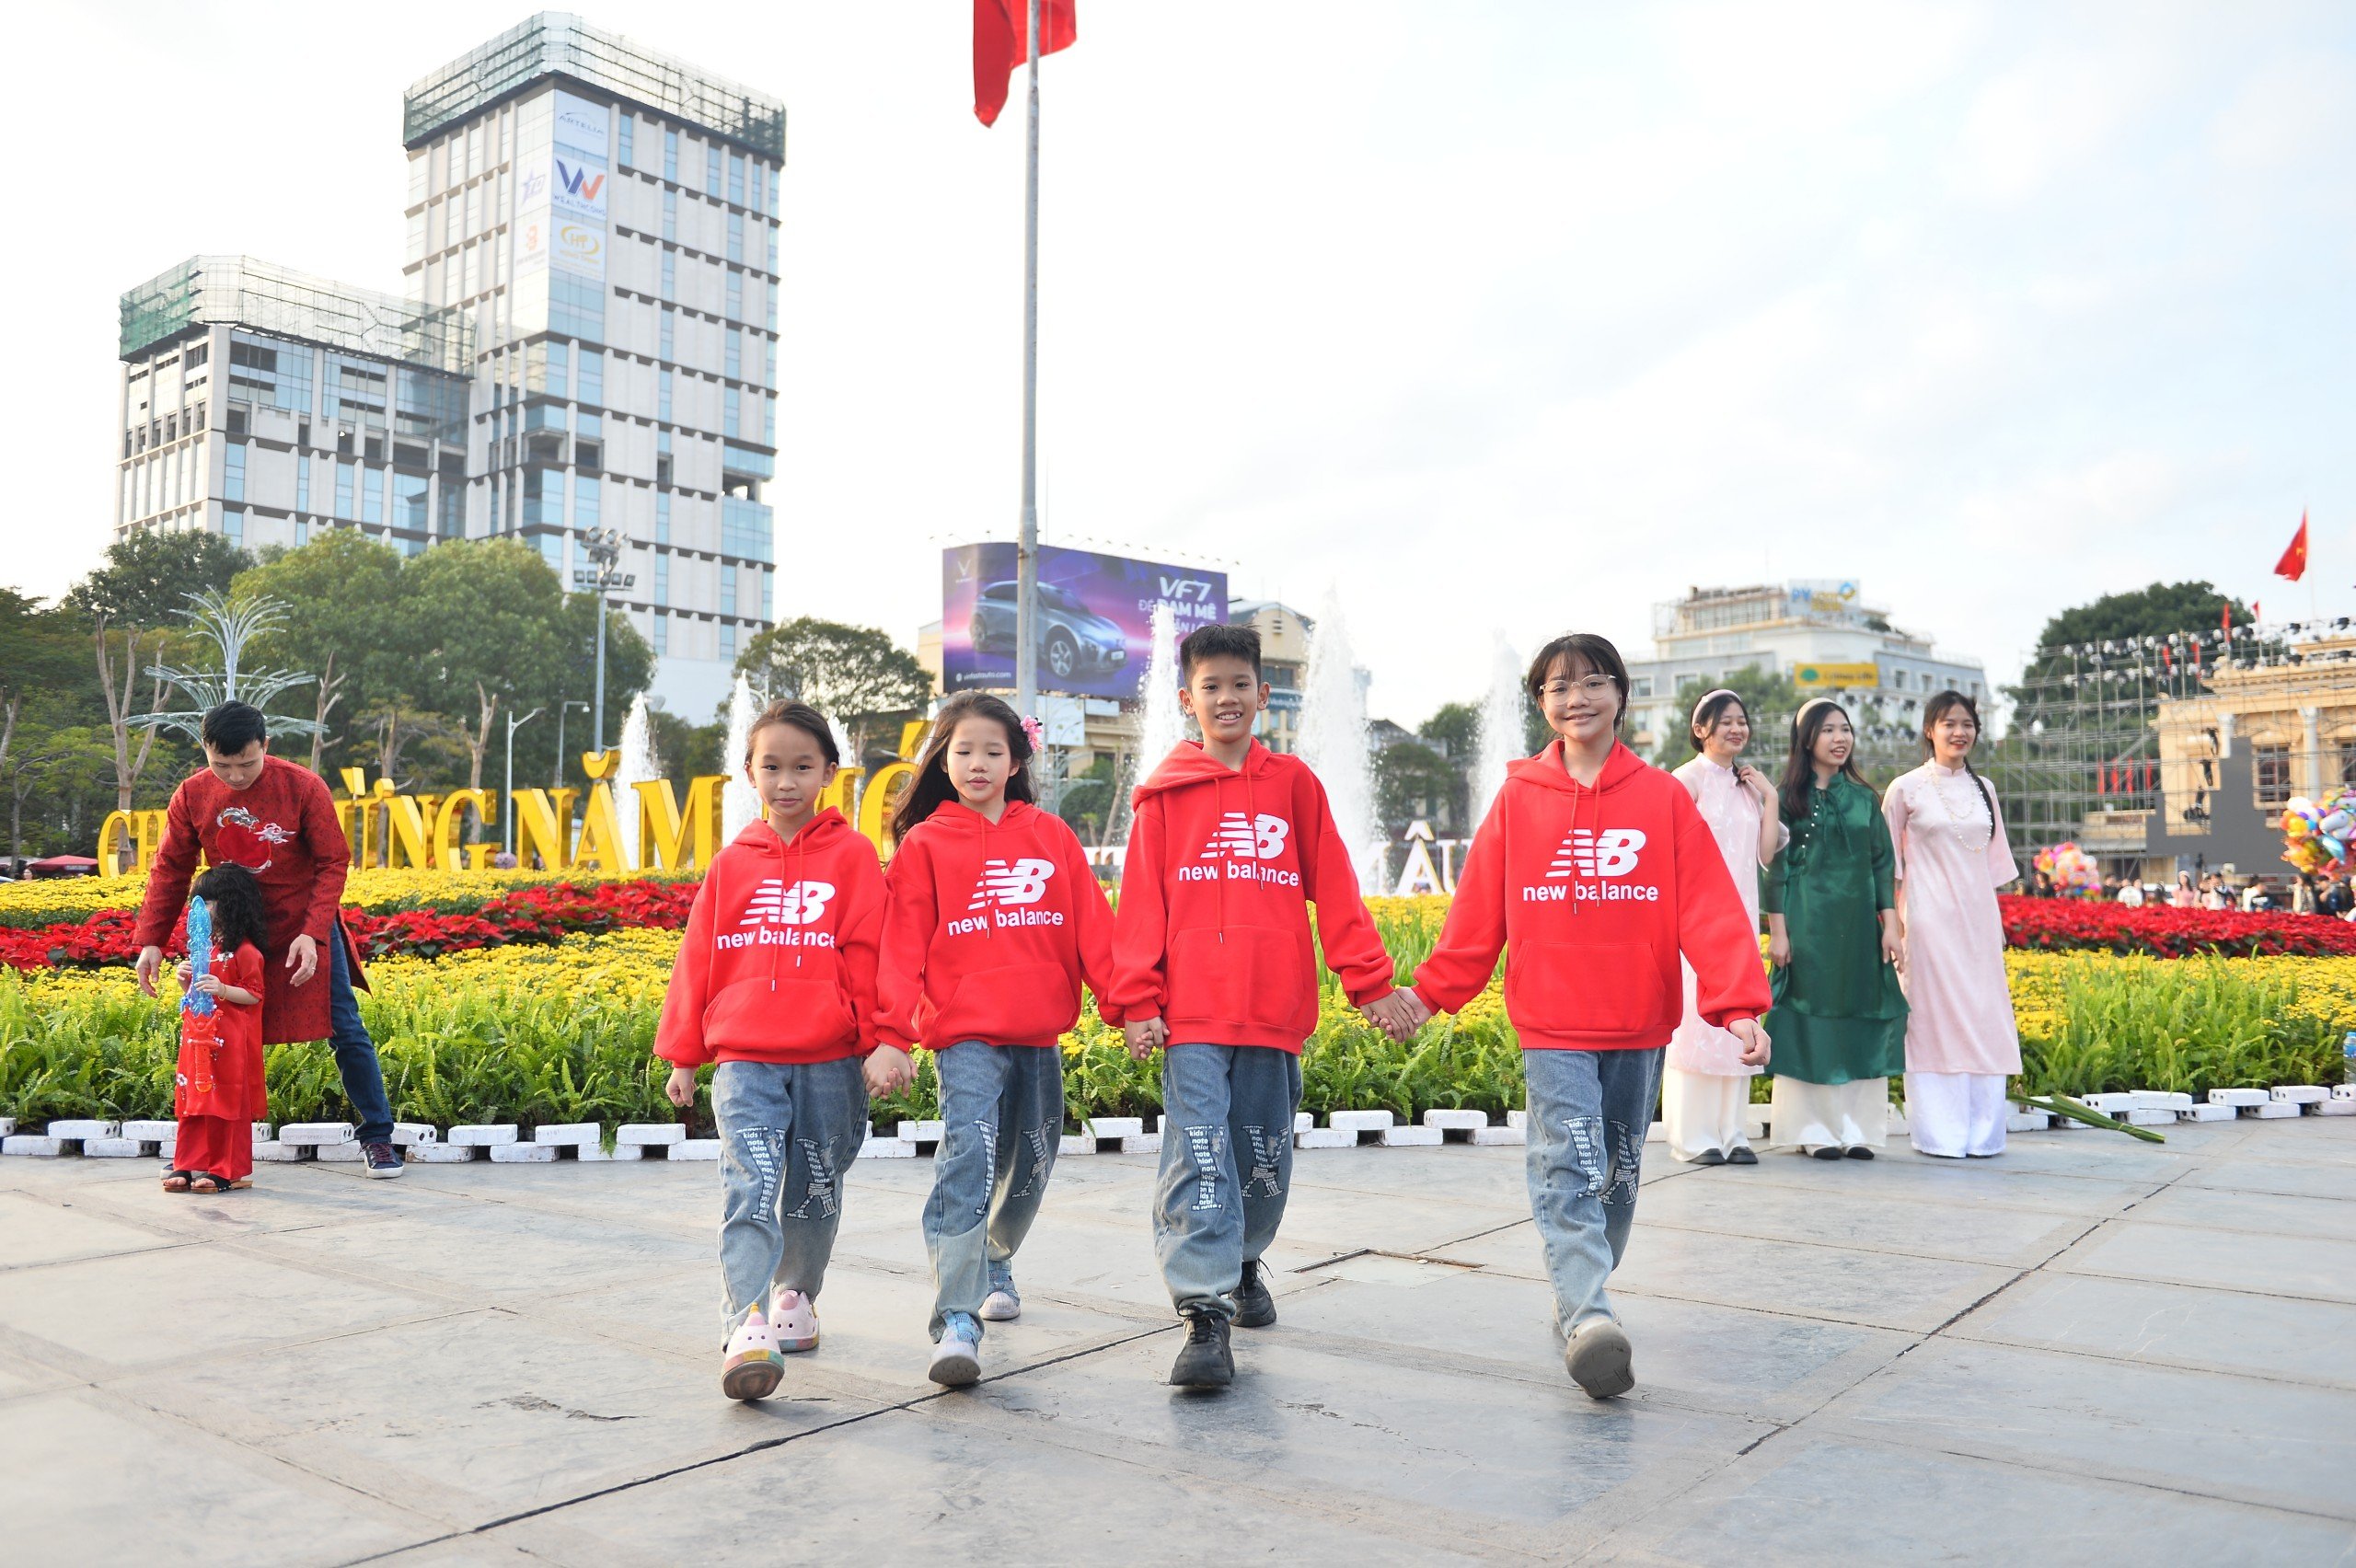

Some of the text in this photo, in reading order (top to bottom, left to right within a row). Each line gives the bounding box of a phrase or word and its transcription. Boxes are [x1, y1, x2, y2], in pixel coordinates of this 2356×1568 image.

[1160, 576, 1212, 602] VF7
[511, 749, 733, 872] NĂM
[1178, 859, 1299, 886] new balance
[1522, 880, 1659, 902] new balance
[947, 906, 1064, 937] new balance
[717, 931, 756, 950] new
